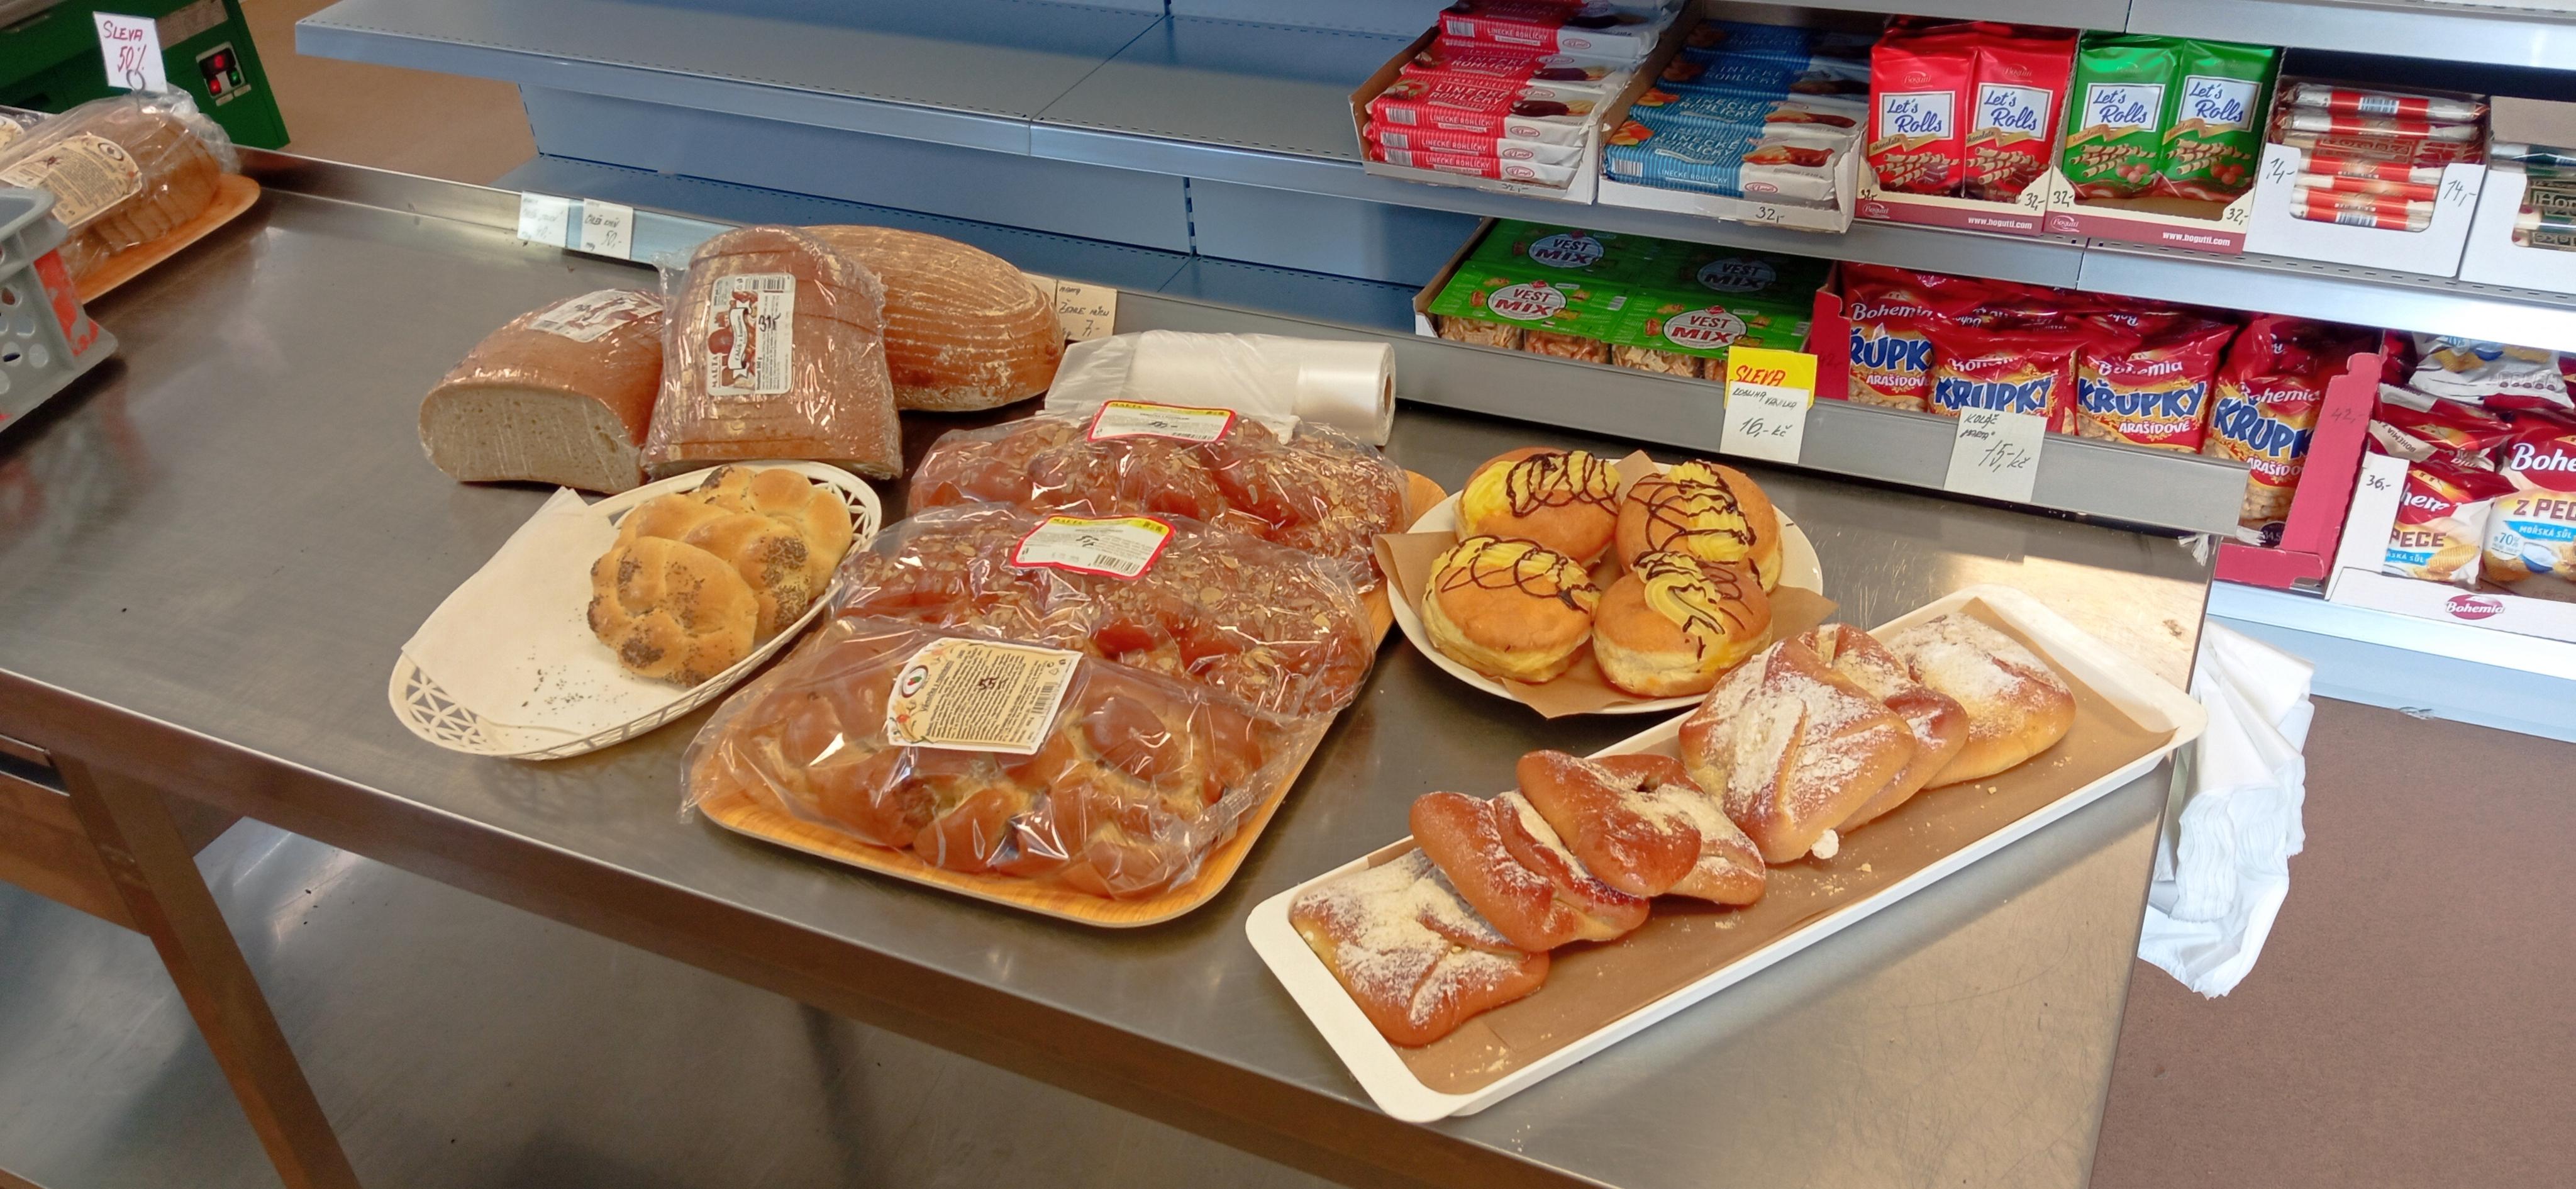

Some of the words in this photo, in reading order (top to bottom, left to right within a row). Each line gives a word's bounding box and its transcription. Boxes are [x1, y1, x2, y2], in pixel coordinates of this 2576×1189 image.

[103, 20, 143, 42] SLEVA
[118, 43, 147, 75] 50%
[2093, 89, 2126, 105] Let's
[2188, 82, 2223, 98] Let's
[1886, 98, 1918, 114] Let's
[1984, 90, 2016, 108] Let's
[1990, 106, 2038, 131] Rolls
[2099, 102, 2148, 125] Rolls
[2195, 99, 2244, 123] Rolls
[1895, 111, 1943, 133] Rolls
[2053, 191, 2074, 208] 32,-
[2443, 180, 2477, 206] 14,-
[2024, 193, 2045, 211] 32,-
[1755, 206, 1785, 223] 32,-
[1968, 216, 2033, 230] www.bogutti.com
[2226, 208, 2249, 225] 32,-
[1553, 239, 1591, 252] VEST
[2162, 231, 2231, 246] www.bogutti.com
[1535, 249, 1588, 264] MIX
[1722, 263, 1762, 276] VEST
[1704, 274, 1762, 288] MIX
[1513, 288, 1553, 303] VEST
[1495, 299, 1552, 316] MIX
[1689, 316, 1731, 329] VEST
[1672, 327, 1732, 343] MIX
[1851, 327, 1935, 372] ŘUPK
[1736, 365, 1786, 386] SLEVA
[2078, 377, 2207, 418] KŘUPKY
[2118, 419, 2191, 435] ARAŠÍDOVÉ
[2214, 398, 2316, 460] KŘUPK
[2511, 442, 2576, 471] Bohe
[2366, 474, 2391, 491] 36,-
[2514, 500, 2530, 516] Z
[2533, 498, 2576, 522] PEC
[2519, 525, 2554, 538] MOŘSKÁ
[2556, 527, 2572, 539] SŮL
[2446, 602, 2505, 614] Bohemia
